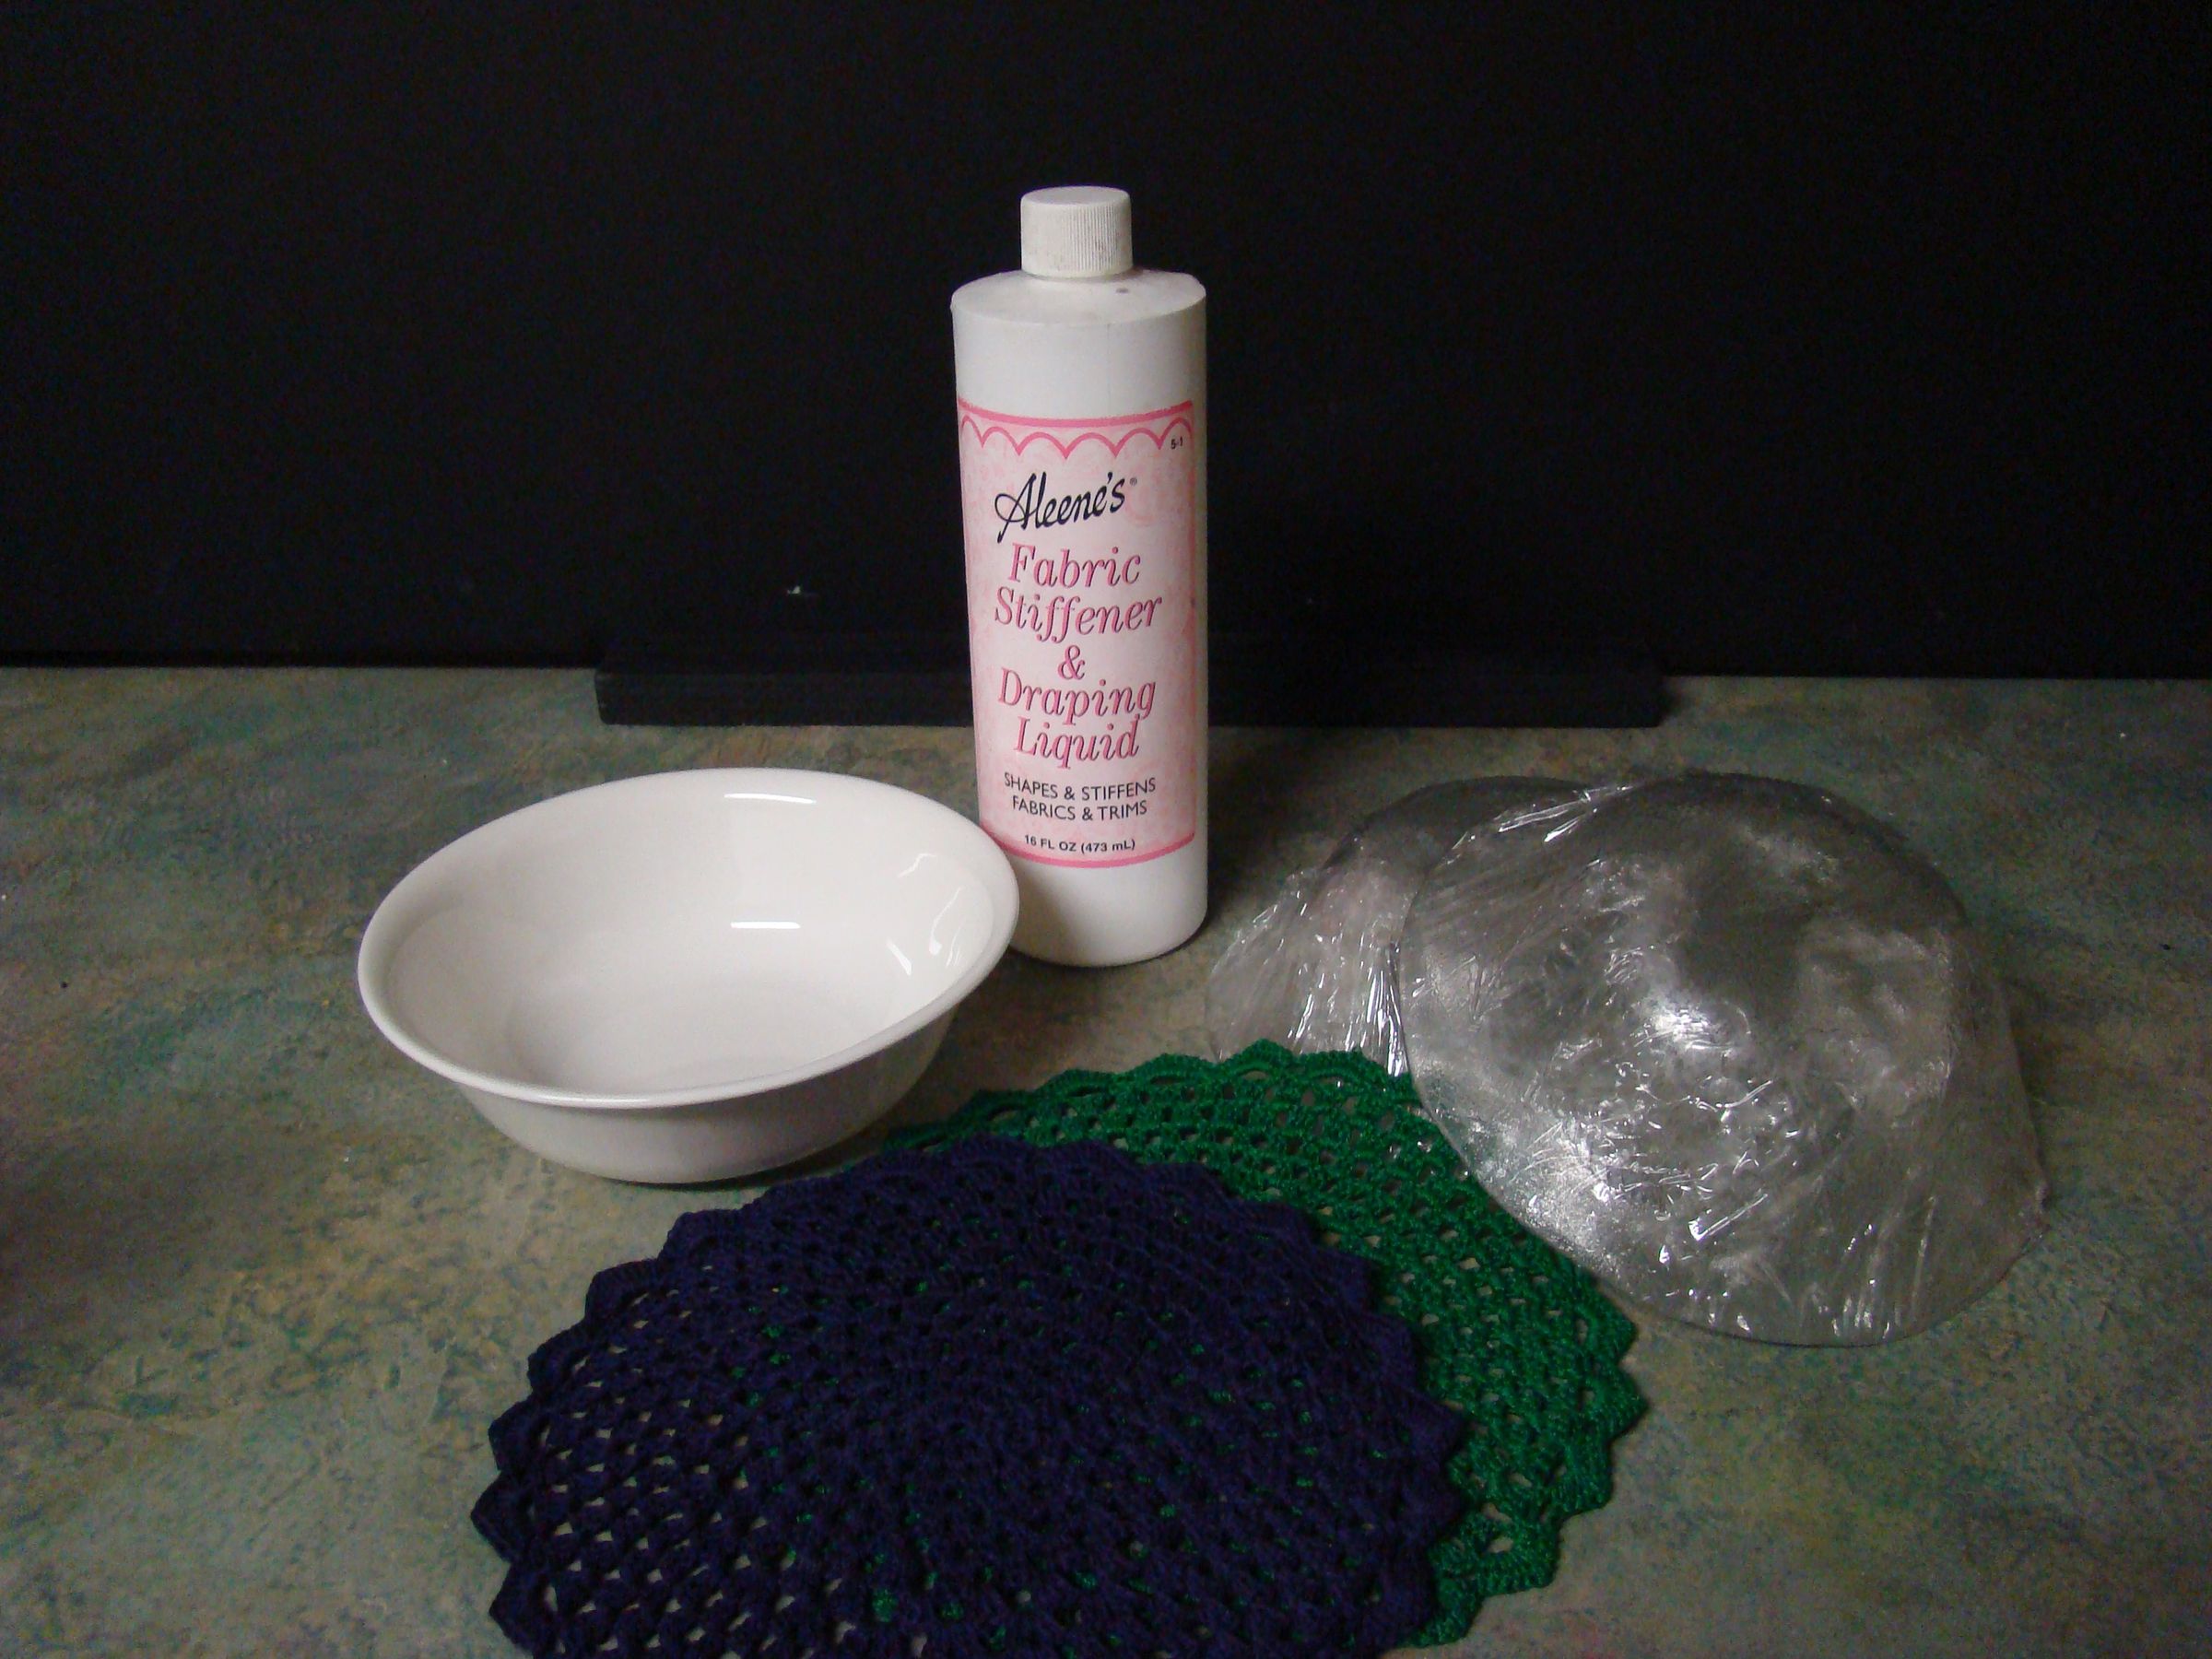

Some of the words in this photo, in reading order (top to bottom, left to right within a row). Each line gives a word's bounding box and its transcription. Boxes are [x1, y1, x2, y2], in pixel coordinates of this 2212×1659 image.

[994, 471, 1126, 543] Aleene's
[1008, 543, 1141, 588] Fabric
[994, 586, 1162, 643] Stiffener
[1057, 645, 1086, 680] &
[998, 668, 1157, 726] Draping
[1015, 714, 1140, 770] Liquid
[1004, 772, 1058, 799] SHAPES
[1064, 786, 1076, 800] &
[1081, 778, 1156, 801] STIFFENS
[1012, 795, 1076, 820] FABRICS
[1081, 806, 1093, 821] &
[1099, 800, 1147, 821] TRIMS
[1024, 834, 1037, 846] 16
[1041, 838, 1055, 851] FL
[1059, 841, 1077, 852] OZ
[1080, 842, 1108, 854] (473
[1112, 840, 1135, 852] mL)
